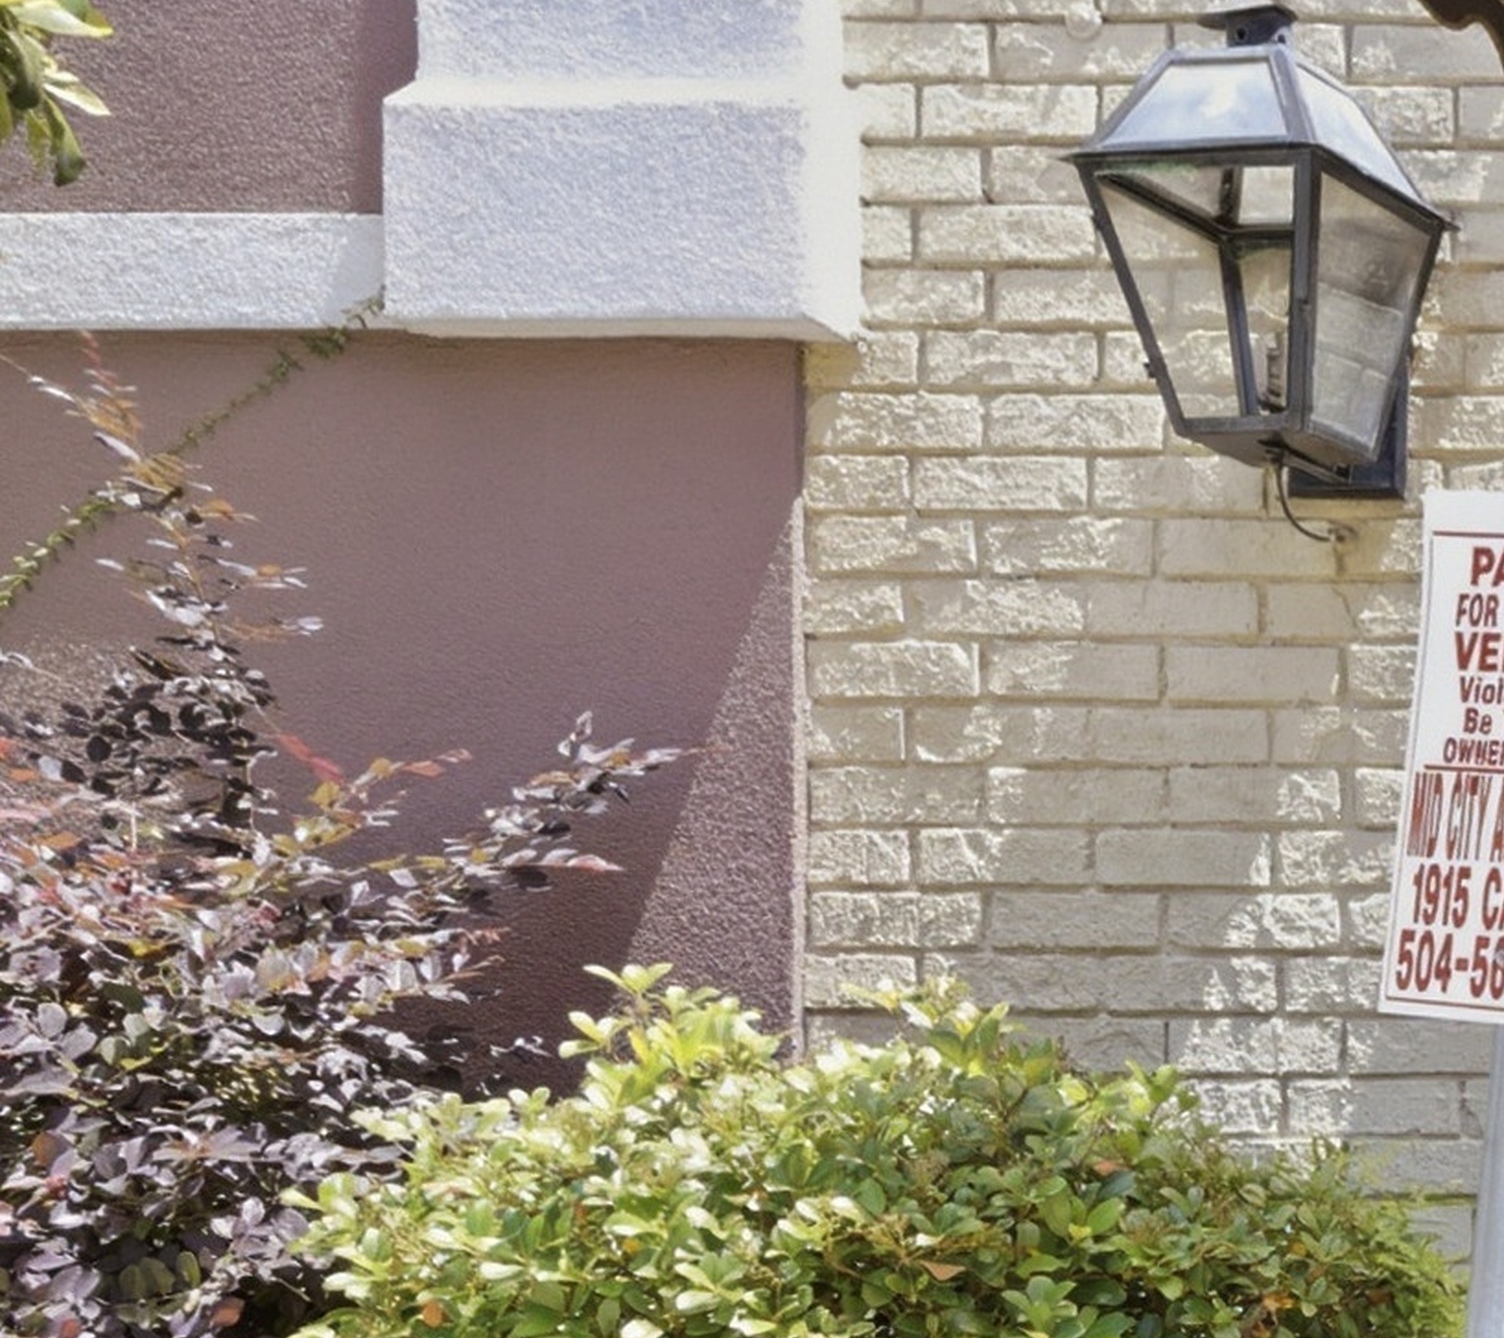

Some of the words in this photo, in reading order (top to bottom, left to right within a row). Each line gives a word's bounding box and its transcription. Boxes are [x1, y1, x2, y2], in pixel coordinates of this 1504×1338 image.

[1456, 593, 1499, 628] FOR
[1463, 708, 1493, 735] Be
[1406, 771, 1444, 858] MID
[1446, 771, 1494, 861] CITY
[1413, 863, 1472, 928] 1915
